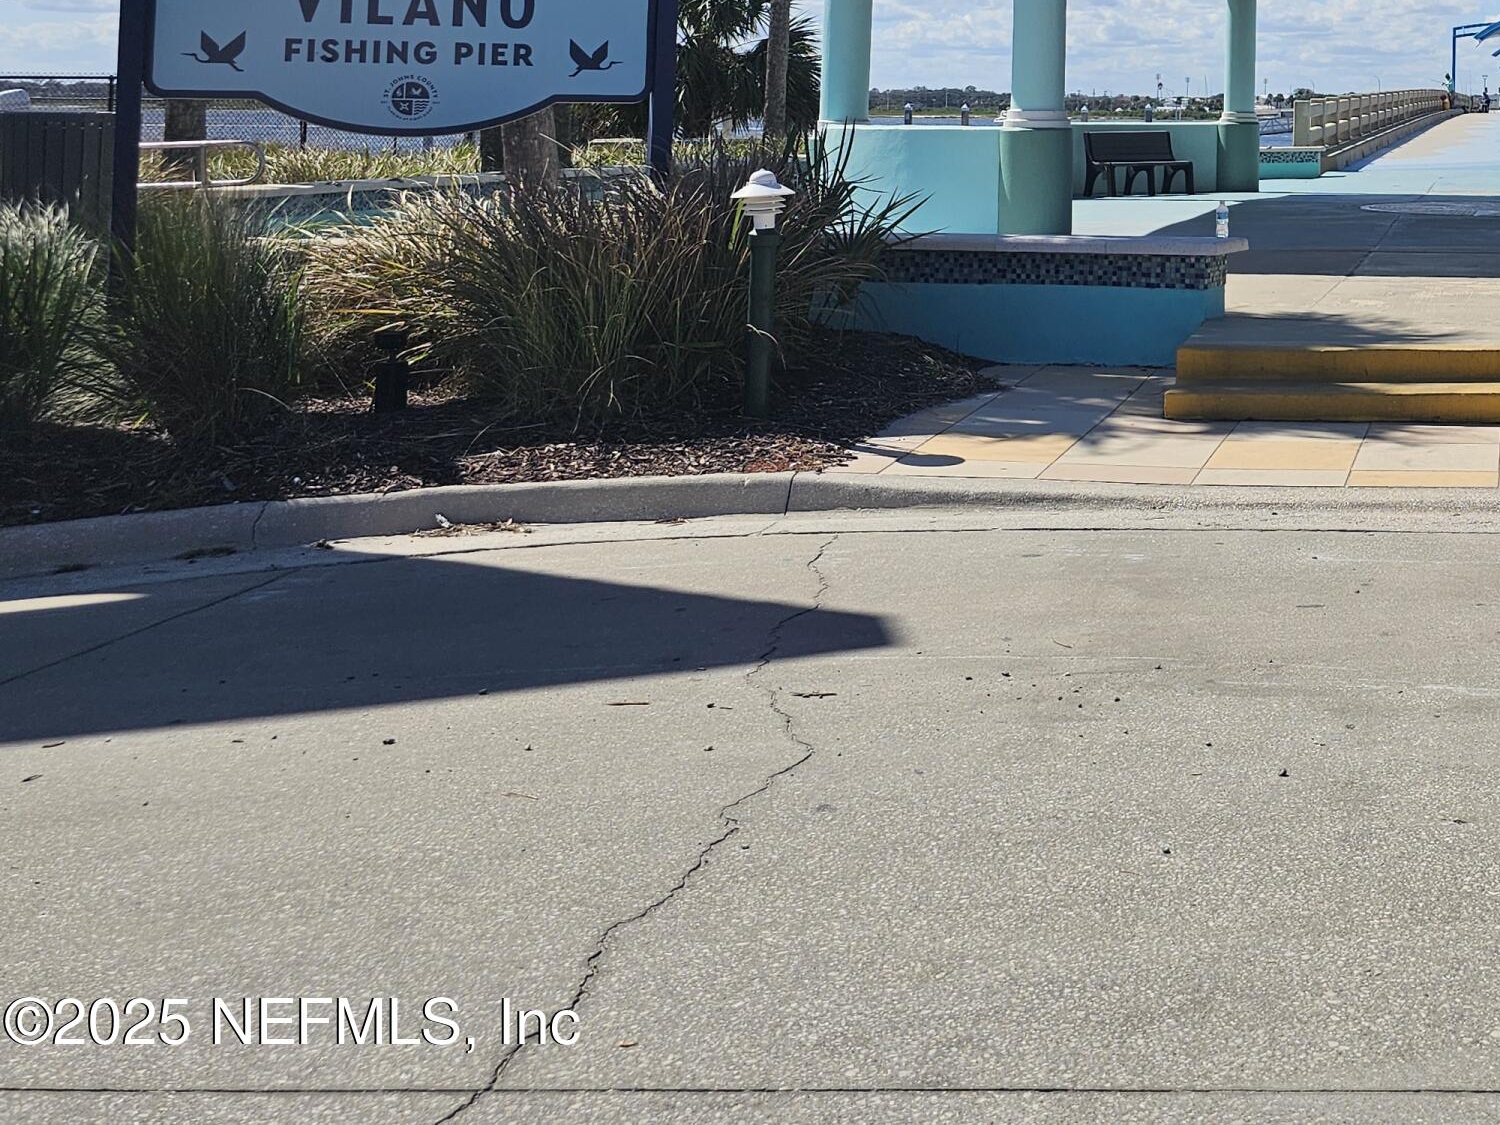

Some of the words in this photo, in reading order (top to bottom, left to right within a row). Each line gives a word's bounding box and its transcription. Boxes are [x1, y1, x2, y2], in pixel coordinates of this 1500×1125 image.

[284, 38, 438, 65] FISHING
[454, 42, 534, 67] PIER
[390, 74, 415, 88] JOHNS
[416, 75, 439, 98] COUNTY
